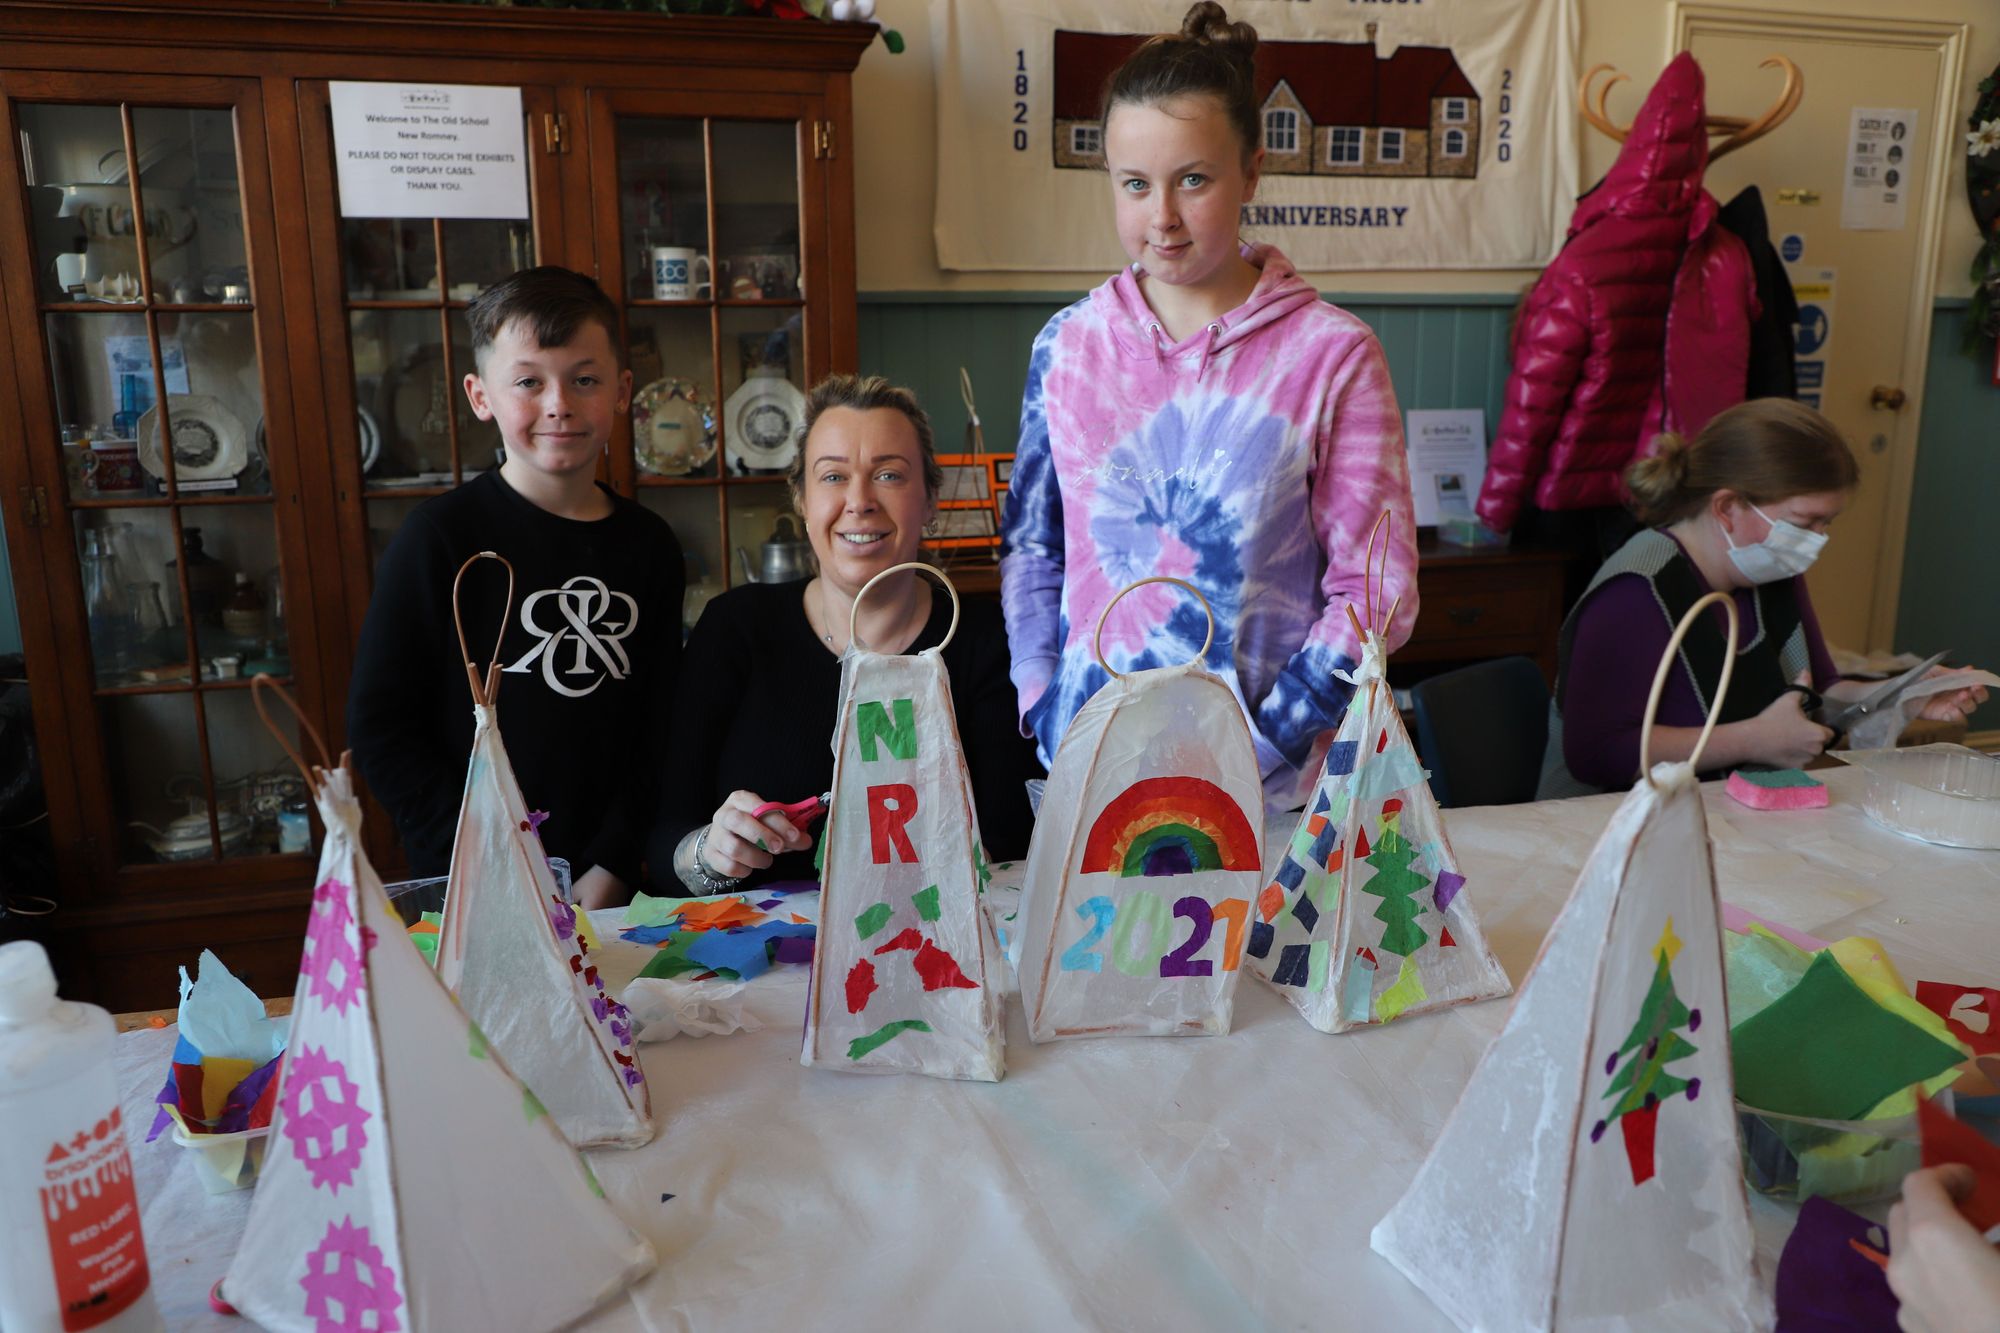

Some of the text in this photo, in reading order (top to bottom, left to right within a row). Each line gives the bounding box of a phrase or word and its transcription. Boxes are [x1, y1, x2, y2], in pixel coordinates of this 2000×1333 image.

[1013, 49, 1028, 151] 1820
[365, 114, 490, 126] Welcome to The Old School
[1498, 69, 1512, 161] 2020
[398, 131, 418, 140] New
[348, 151, 515, 163] PLEASE DO NOT TOUCH THE EXHIBITS
[390, 166, 404, 174] OR
[406, 166, 443, 175] DISPLAY
[407, 182, 438, 190] THANK
[1239, 205, 1408, 227] ANNIVERSARY
[1060, 891, 1250, 978] 2021
